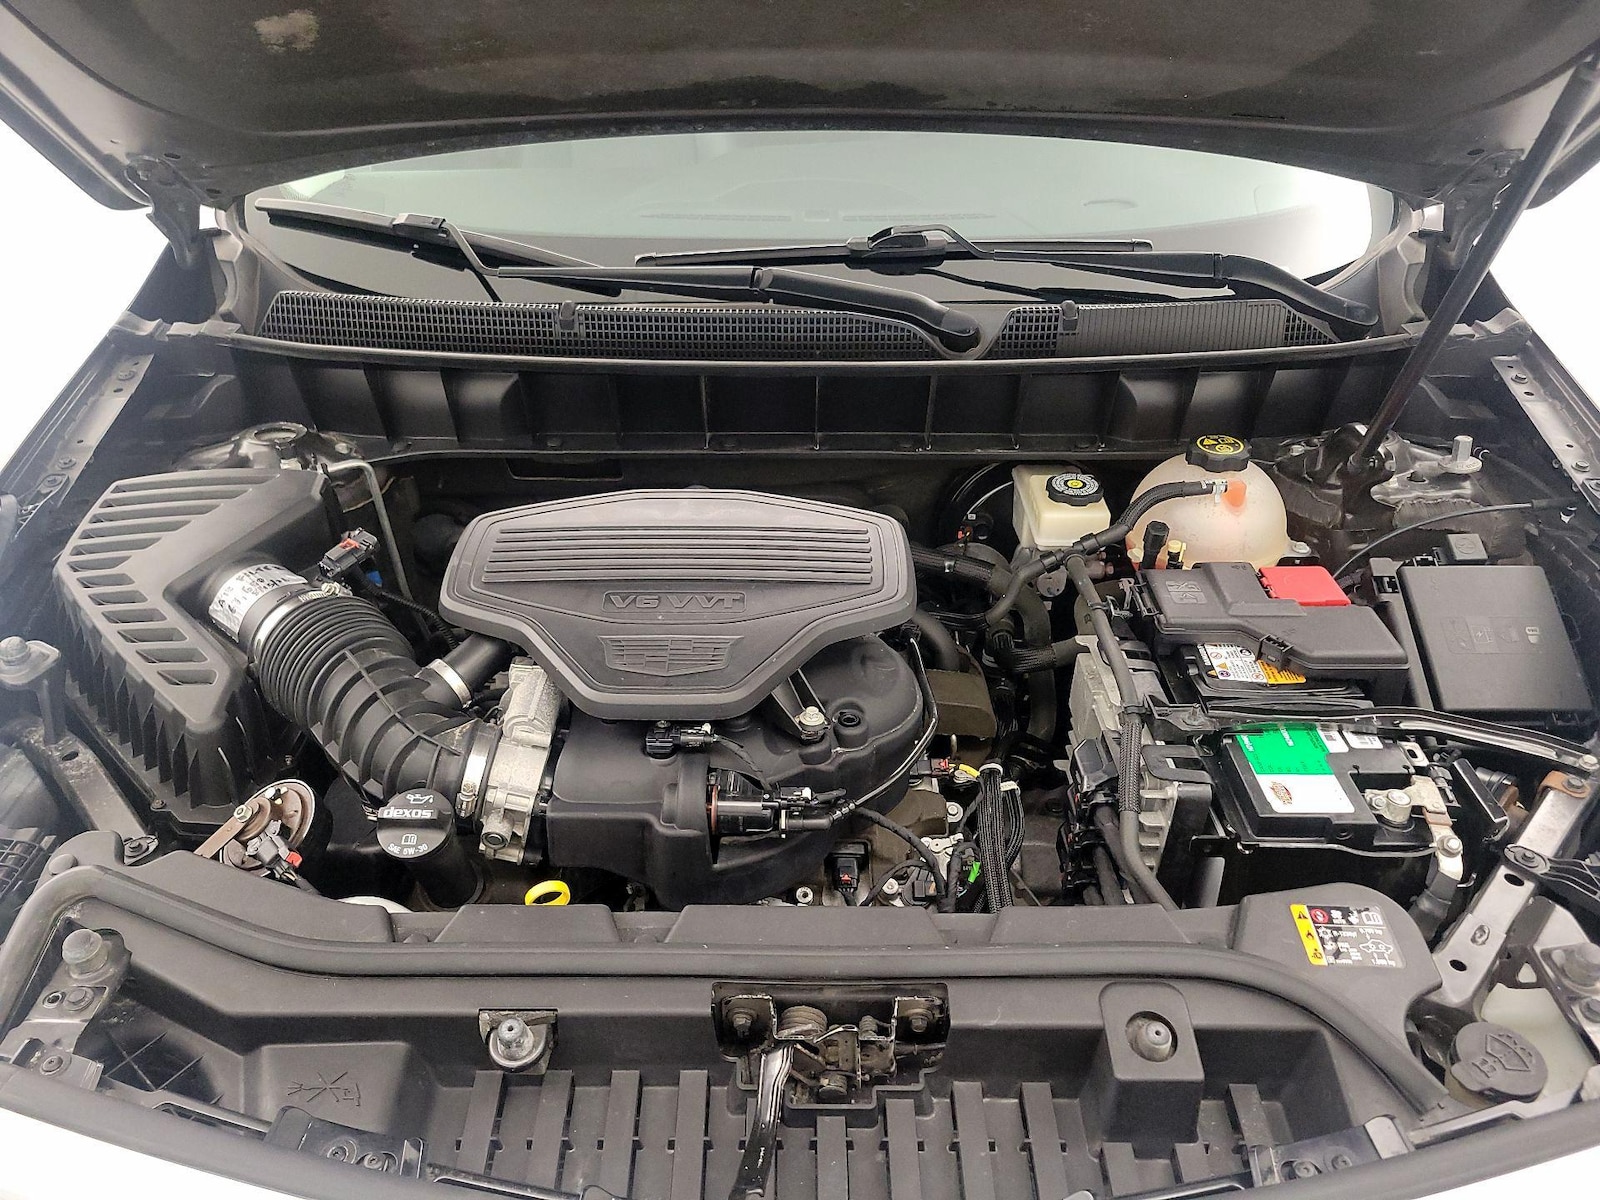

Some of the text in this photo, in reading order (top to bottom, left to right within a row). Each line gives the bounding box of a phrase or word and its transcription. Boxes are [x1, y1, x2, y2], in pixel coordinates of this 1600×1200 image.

[609, 593, 742, 609] V6 VVT
[383, 806, 434, 819] dexos
[387, 843, 429, 856] SAE 5W-30
